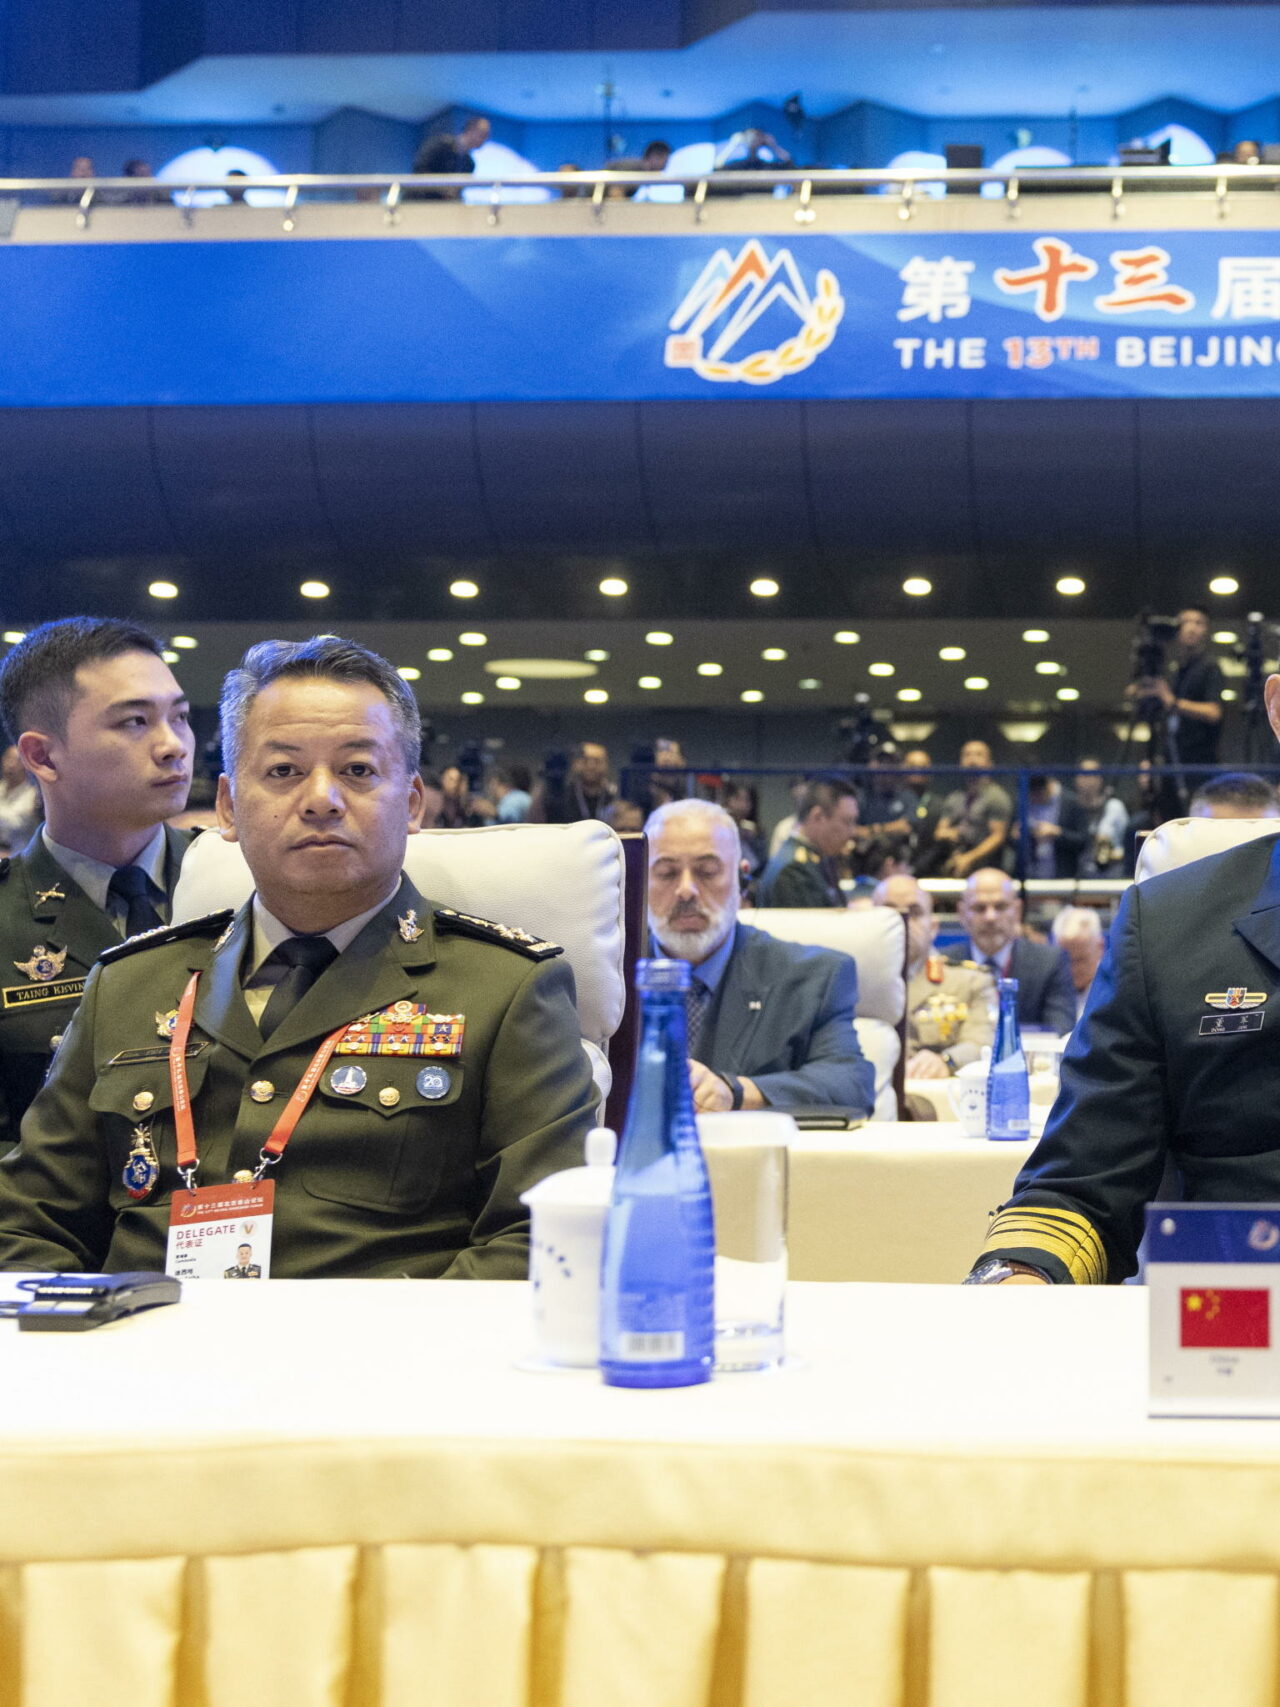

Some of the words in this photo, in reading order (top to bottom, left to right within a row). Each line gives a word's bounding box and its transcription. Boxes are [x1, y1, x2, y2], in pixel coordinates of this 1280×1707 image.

[893, 337, 987, 369] THE
[1003, 335, 1100, 369] 13TH
[16, 986, 49, 1001] TAING
[176, 1224, 237, 1241] DELEGATE
[175, 1239, 204, 1250] 代表证
